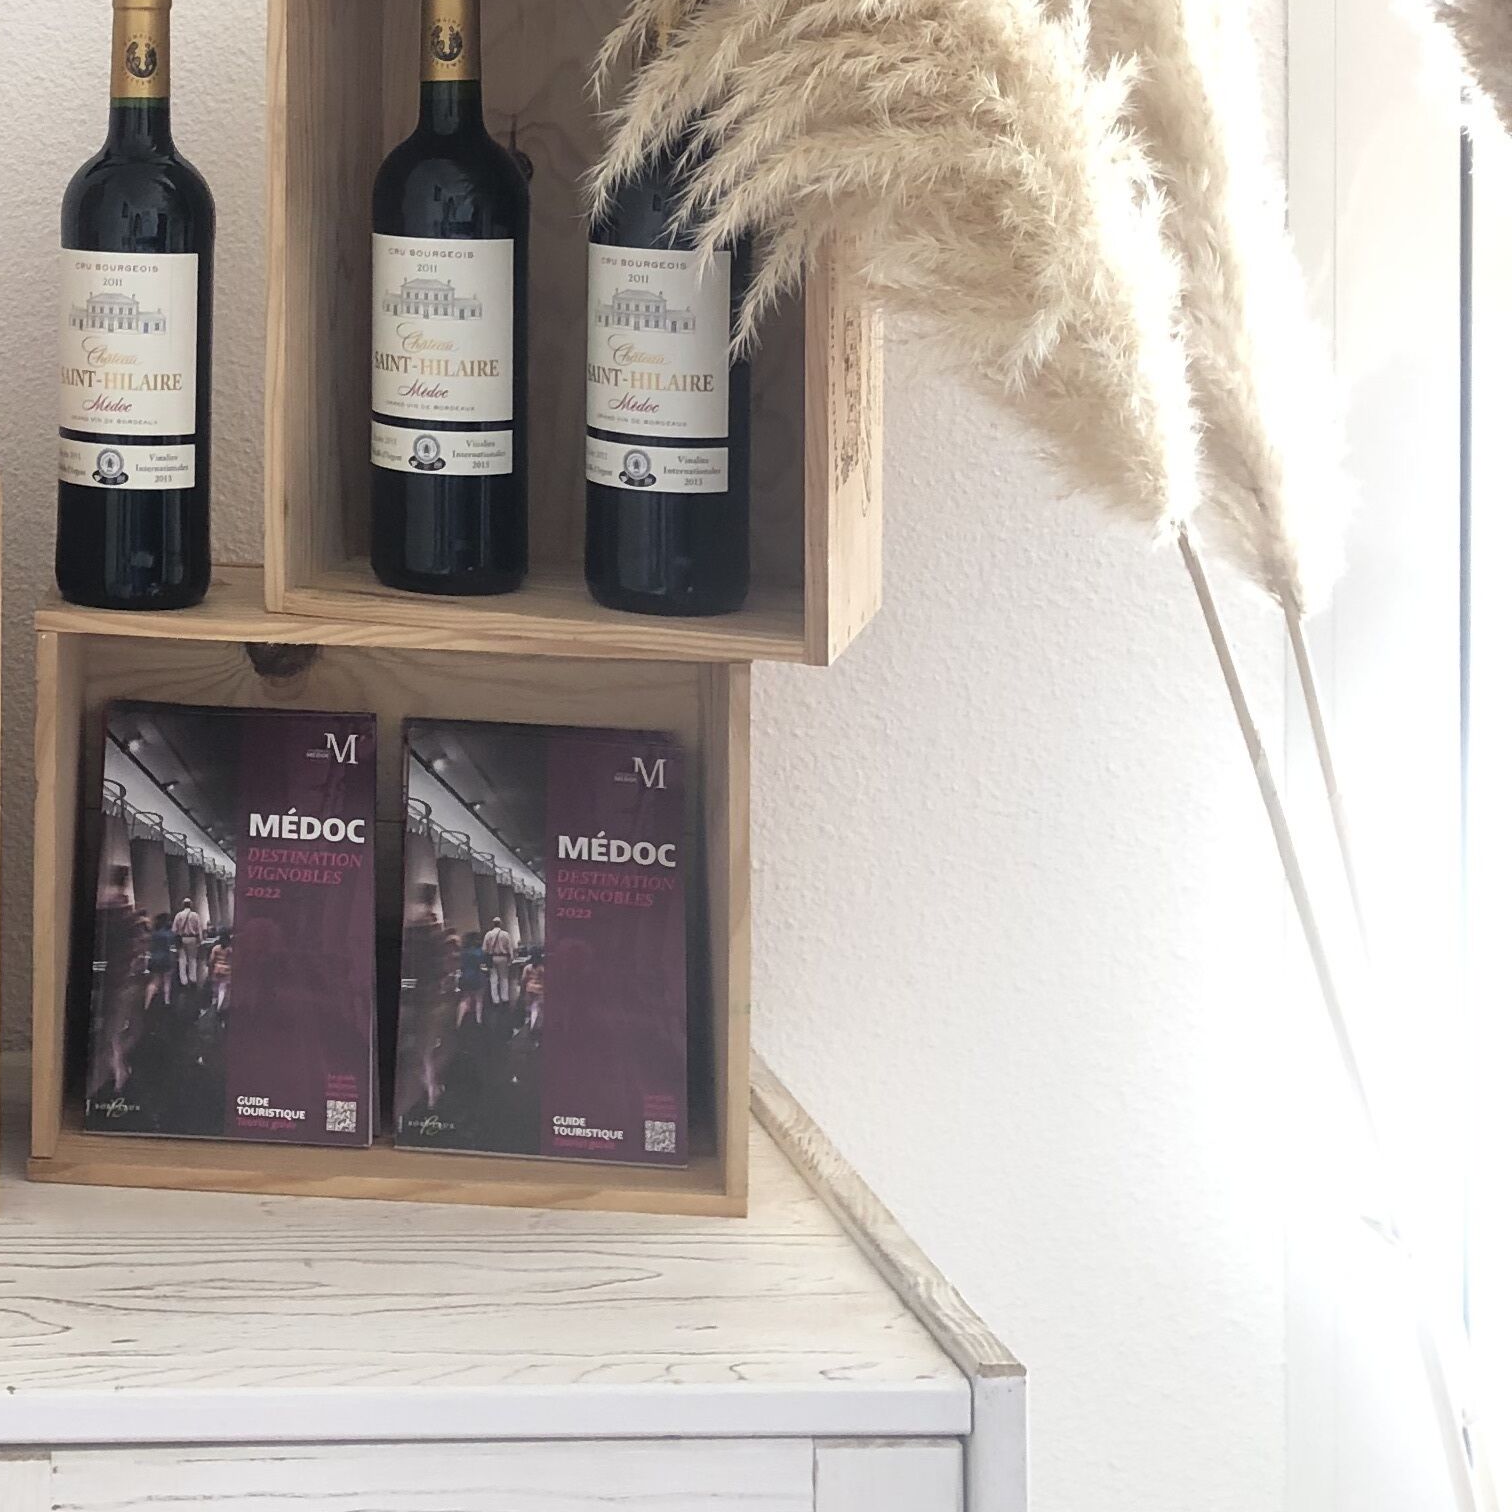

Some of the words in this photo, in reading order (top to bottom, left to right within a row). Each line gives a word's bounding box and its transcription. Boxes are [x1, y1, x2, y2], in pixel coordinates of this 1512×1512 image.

[388, 247, 405, 256] CRU
[409, 249, 475, 259] BOURGEOIS
[74, 262, 92, 270] CRU
[95, 263, 159, 273] BOURGEOIS
[416, 263, 438, 273] 2011
[620, 258, 687, 271] BOURGEOIS
[103, 277, 123, 287] 2011
[627, 273, 649, 284] 2011
[323, 732, 359, 765] M
[631, 756, 668, 790] M
[249, 807, 365, 844] MÉDOC
[558, 830, 677, 868] MÉDOC
[247, 847, 363, 868] DESTINATION
[247, 865, 344, 885] VIGNOBLES
[557, 869, 675, 890] DESTINATION
[246, 886, 281, 899] 2022
[557, 887, 654, 908] VIGNOBLES
[556, 907, 592, 919] 2022
[236, 1095, 270, 1107] GUIDE
[236, 1106, 306, 1121] TOURISTIQUE
[552, 1115, 587, 1127] GUIDE
[552, 1126, 624, 1140] TOURISTIQUE
